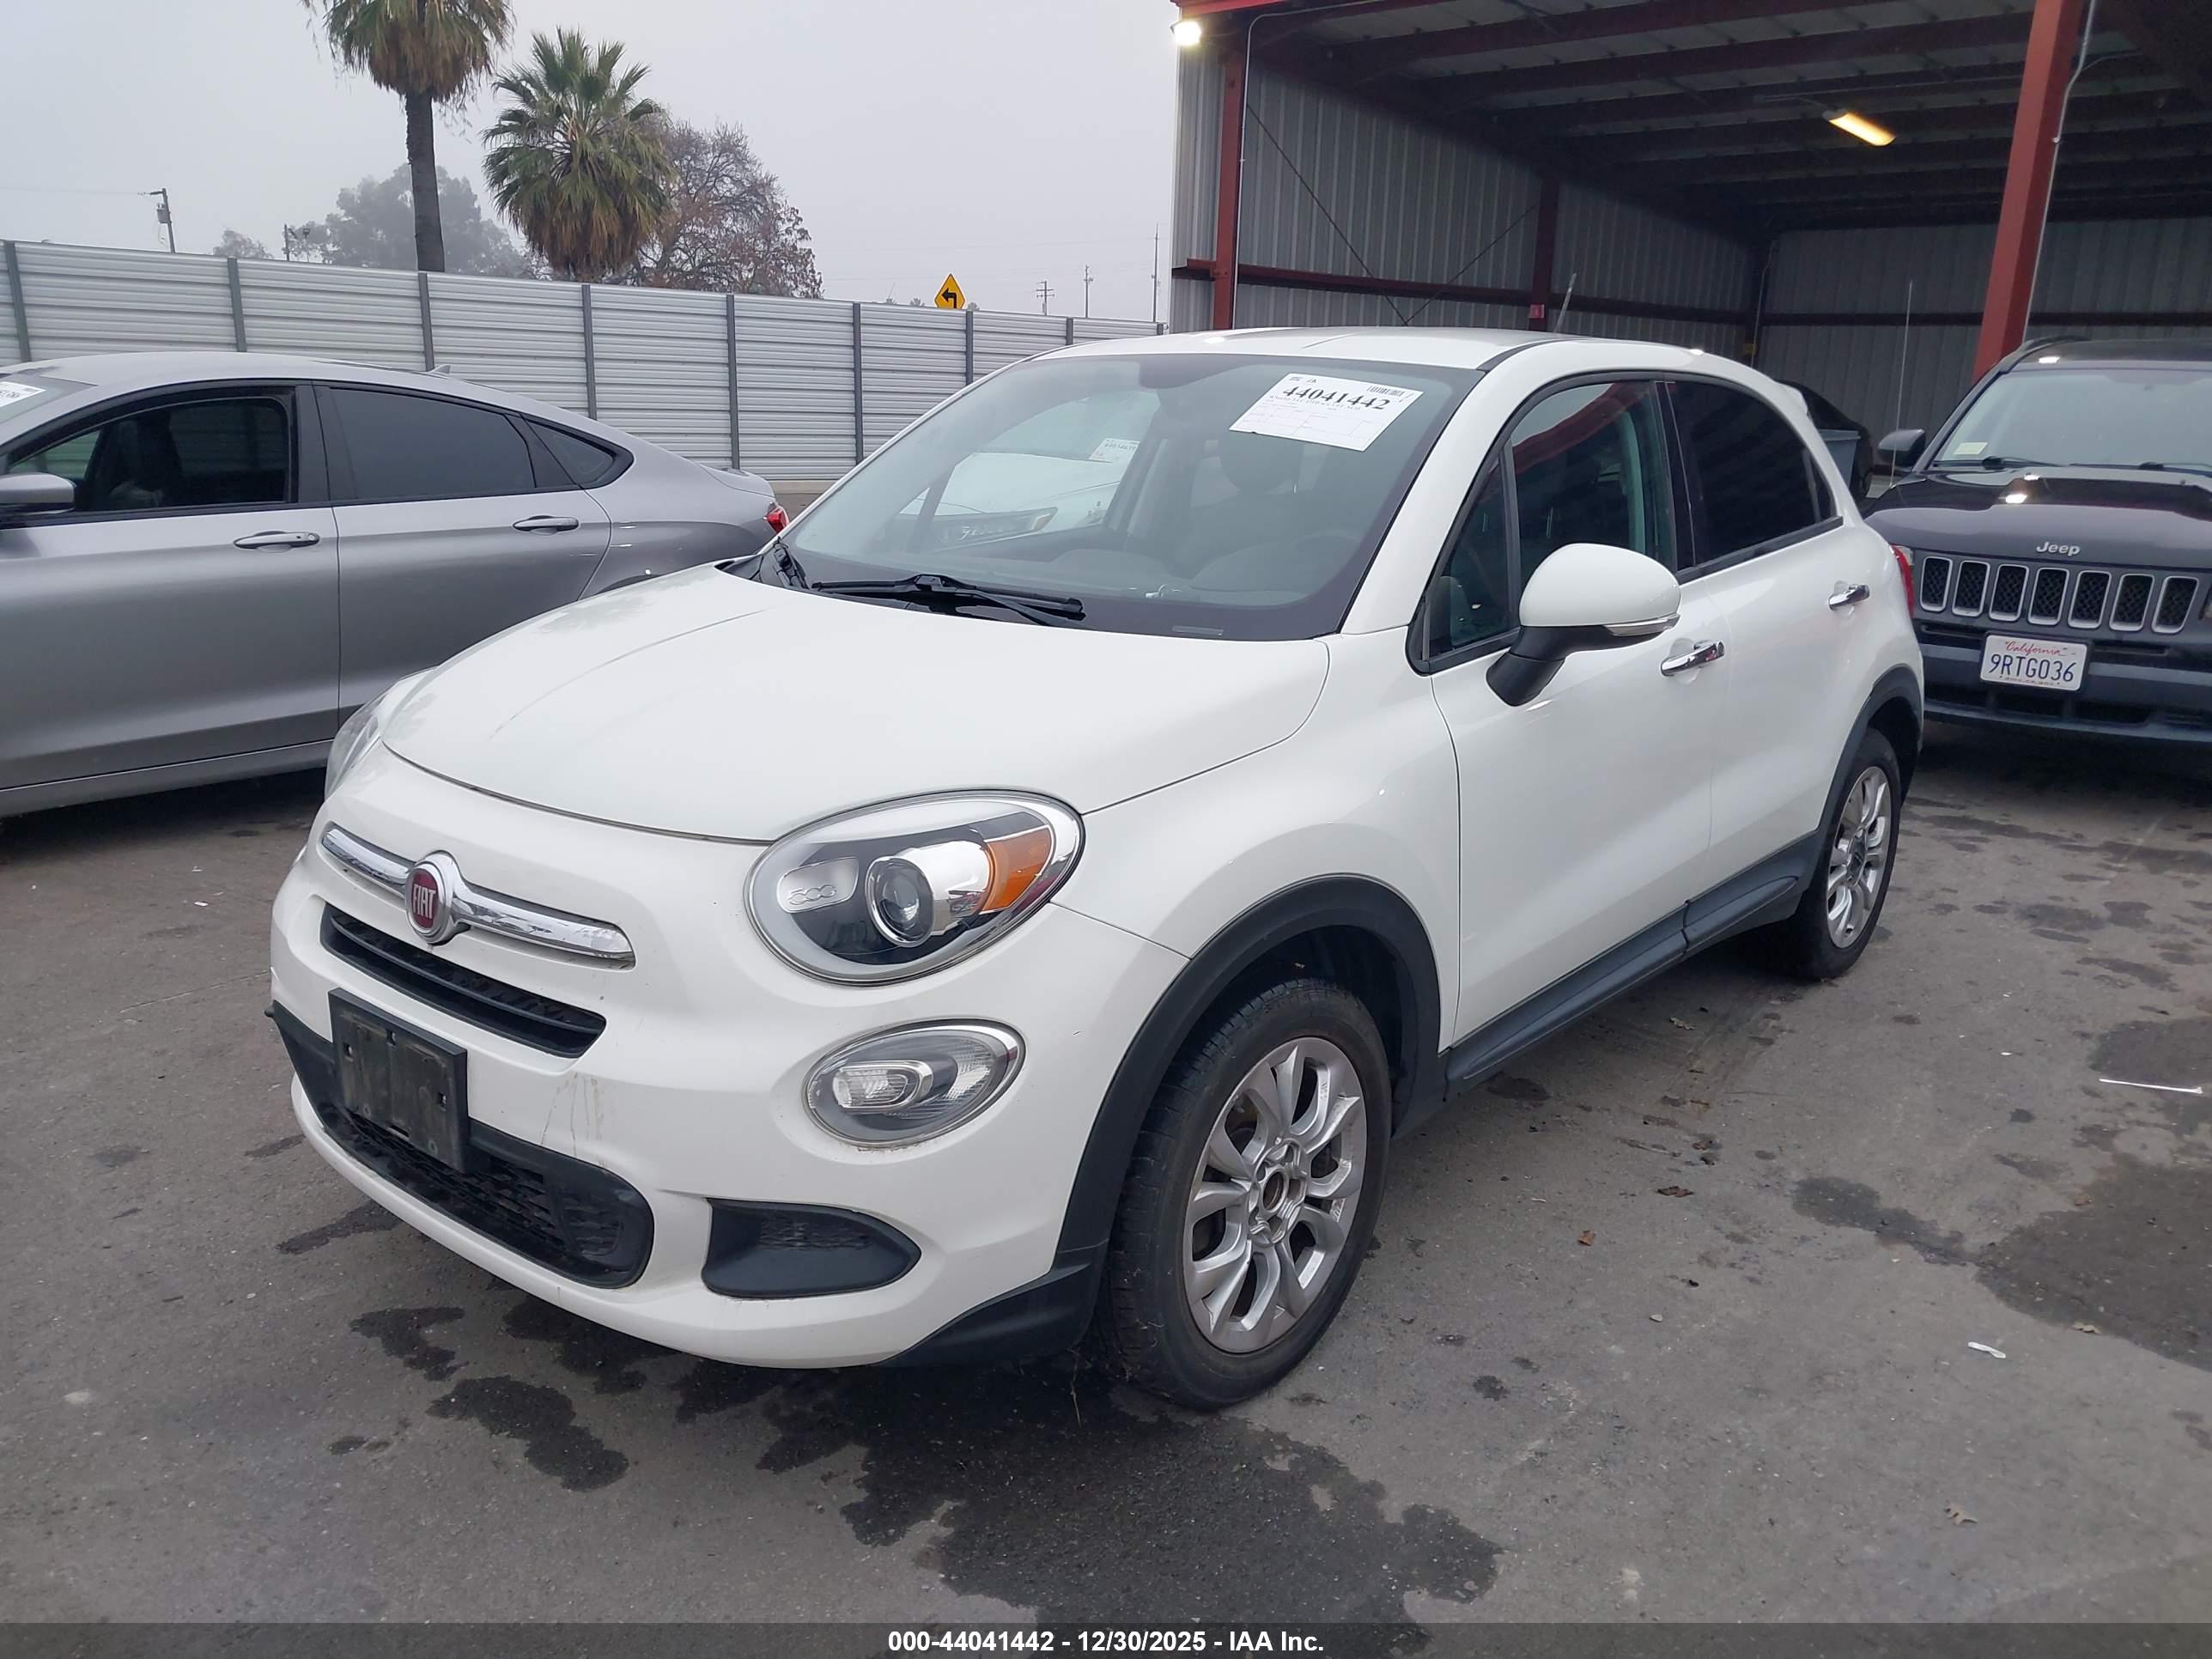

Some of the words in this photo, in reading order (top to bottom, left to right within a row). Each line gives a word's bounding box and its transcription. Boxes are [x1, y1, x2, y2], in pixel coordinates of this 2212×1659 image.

[1282, 386, 1389, 410] 44041442
[2036, 541, 2080, 556] Jeep
[2006, 641, 2063, 656] California
[1989, 653, 2076, 683] 9RTG036
[412, 884, 436, 920] FIAT
[788, 884, 836, 905] 500
